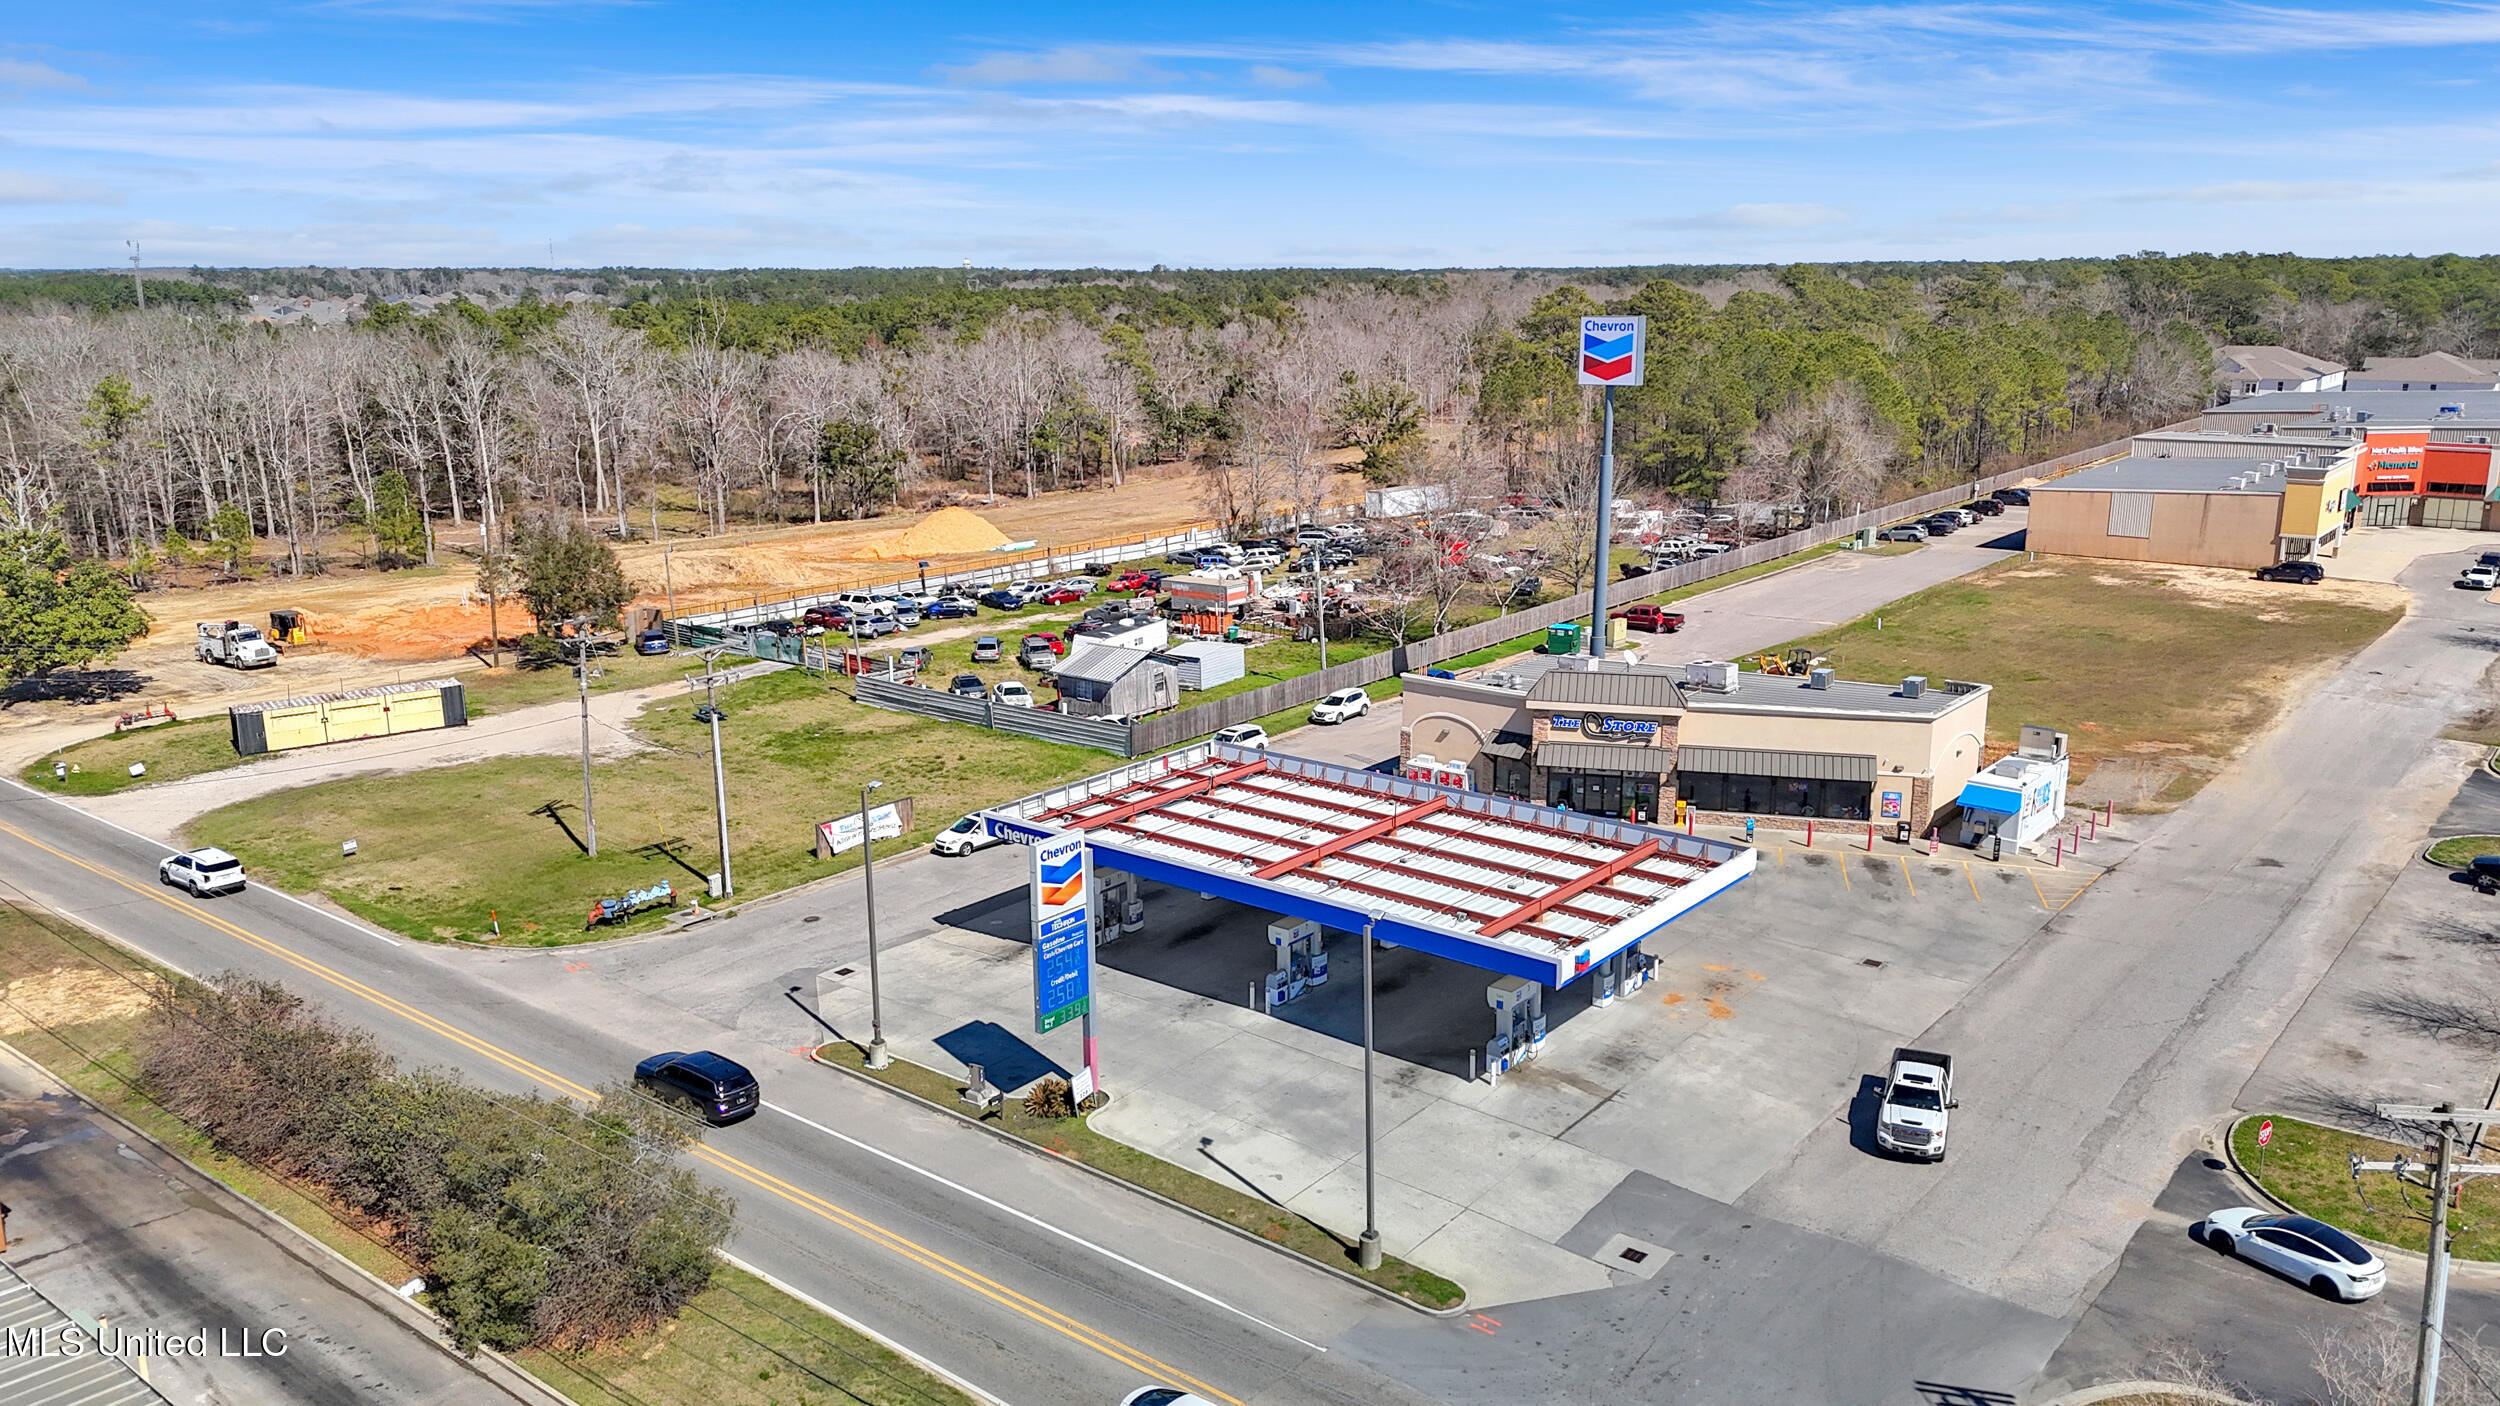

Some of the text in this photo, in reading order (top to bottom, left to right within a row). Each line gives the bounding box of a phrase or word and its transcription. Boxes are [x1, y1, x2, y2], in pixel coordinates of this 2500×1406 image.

[1584, 320, 1634, 331] Chevron
[2378, 460, 2419, 469] Memorial
[994, 823, 1050, 847] Chevro
[1040, 840, 1082, 862] Chevron
[1042, 936, 1066, 950] Gasoline
